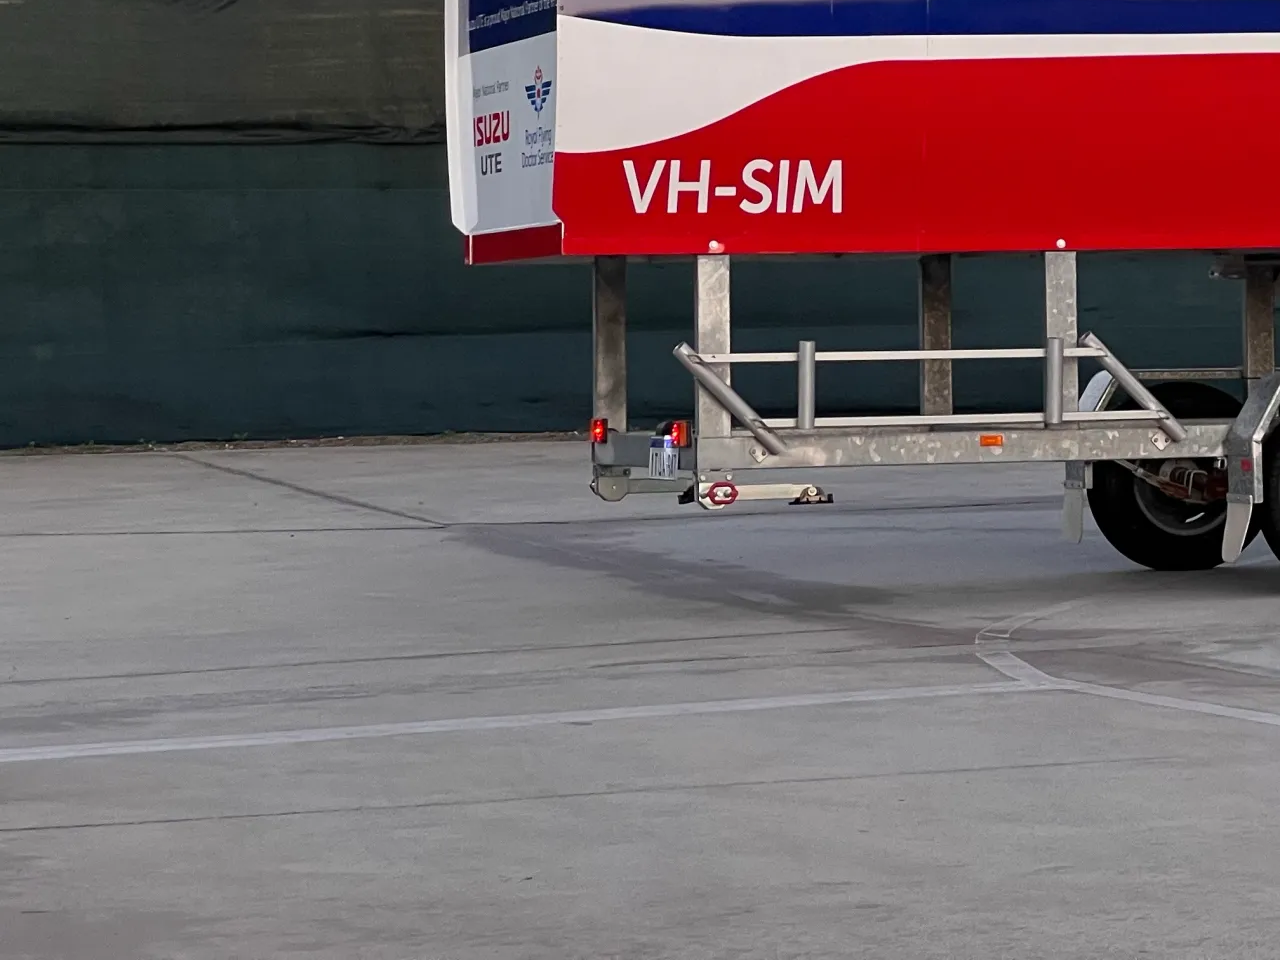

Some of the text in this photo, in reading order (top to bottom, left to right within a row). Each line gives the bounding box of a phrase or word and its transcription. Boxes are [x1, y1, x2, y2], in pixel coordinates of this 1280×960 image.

[474, 110, 510, 147] ISUZU
[525, 128, 538, 149] Royal
[481, 152, 502, 175] UTE
[522, 151, 538, 169] Doctor
[622, 158, 843, 214] VH-SIM
